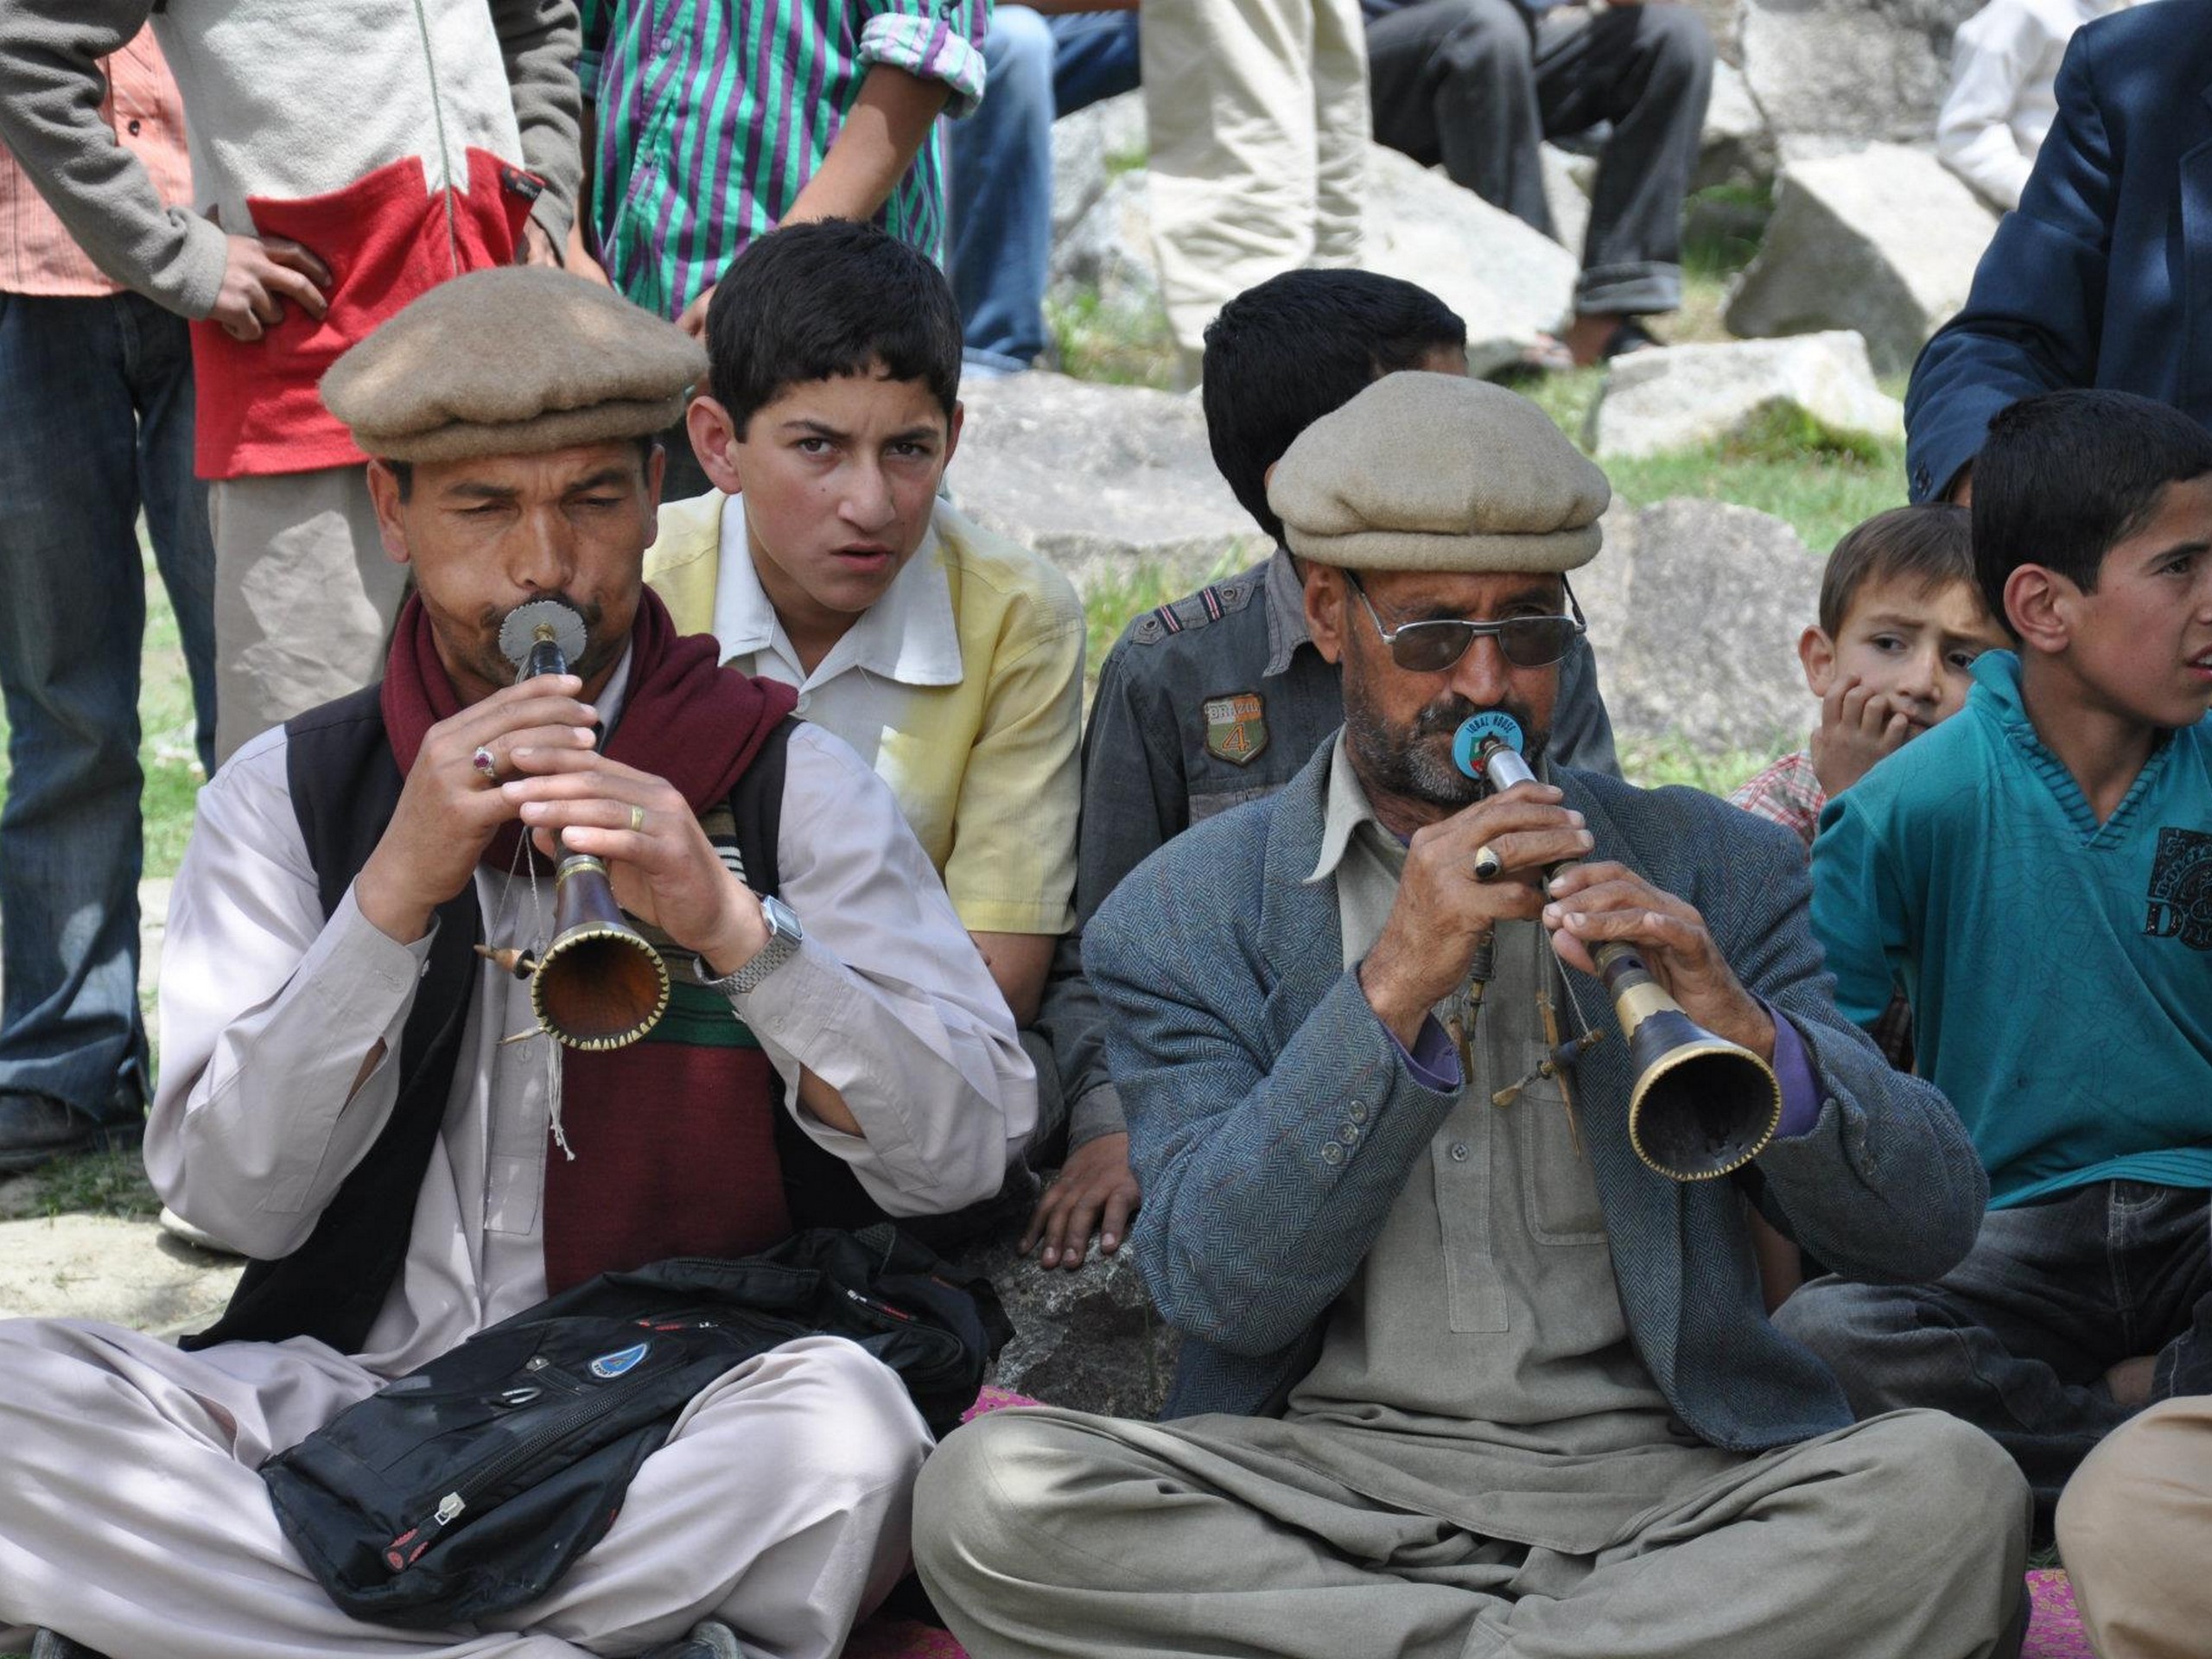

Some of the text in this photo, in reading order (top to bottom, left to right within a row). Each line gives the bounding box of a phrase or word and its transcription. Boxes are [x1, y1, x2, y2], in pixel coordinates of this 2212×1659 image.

[1209, 702, 1261, 720] BRAZIL
[1493, 715, 1516, 734] HOUSE
[1222, 723, 1250, 752] 4
